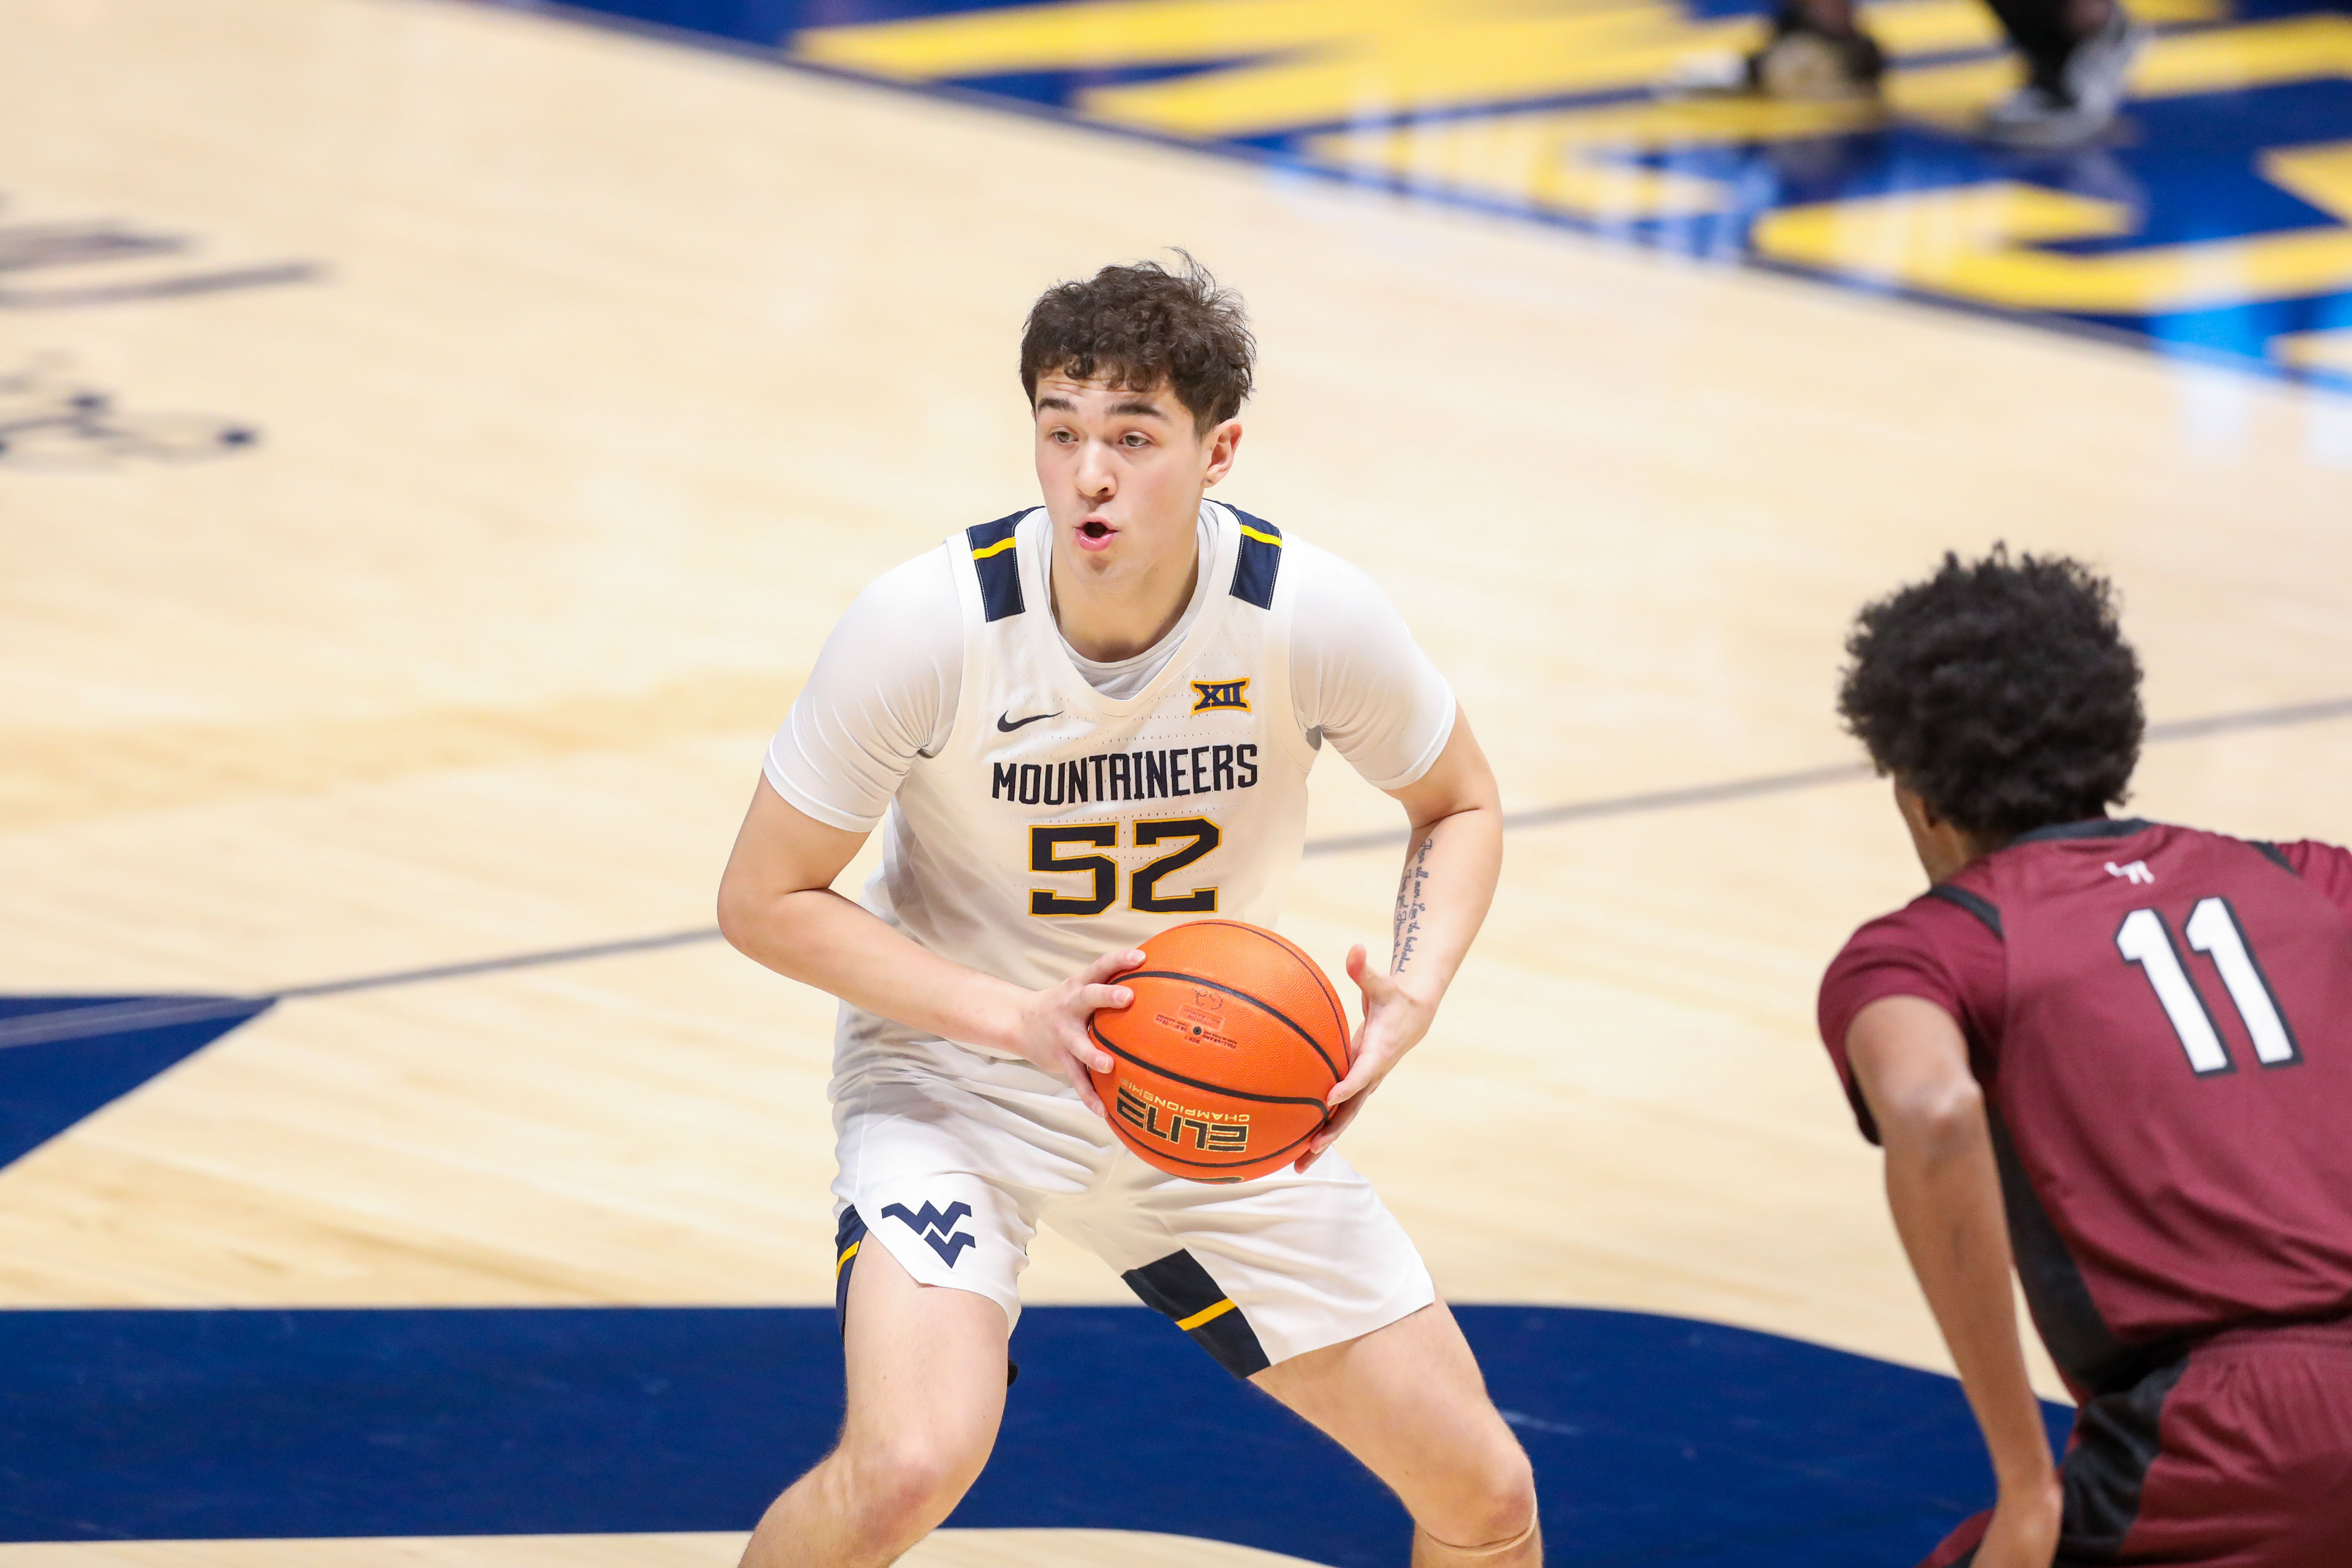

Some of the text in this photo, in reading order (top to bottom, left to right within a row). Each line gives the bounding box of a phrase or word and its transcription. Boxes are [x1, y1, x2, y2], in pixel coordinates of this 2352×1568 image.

[1193, 680, 1247, 711] XII
[992, 744, 1258, 806] MOUNTAINEERS
[1029, 815, 1223, 916] 52
[1416, 866, 1428, 878] all
[1407, 920, 1420, 934] the
[2116, 897, 2303, 1078] 11
[1116, 1085, 1249, 1153] ELITE
[1120, 1077, 1250, 1122] CHAMPIONSHIP
